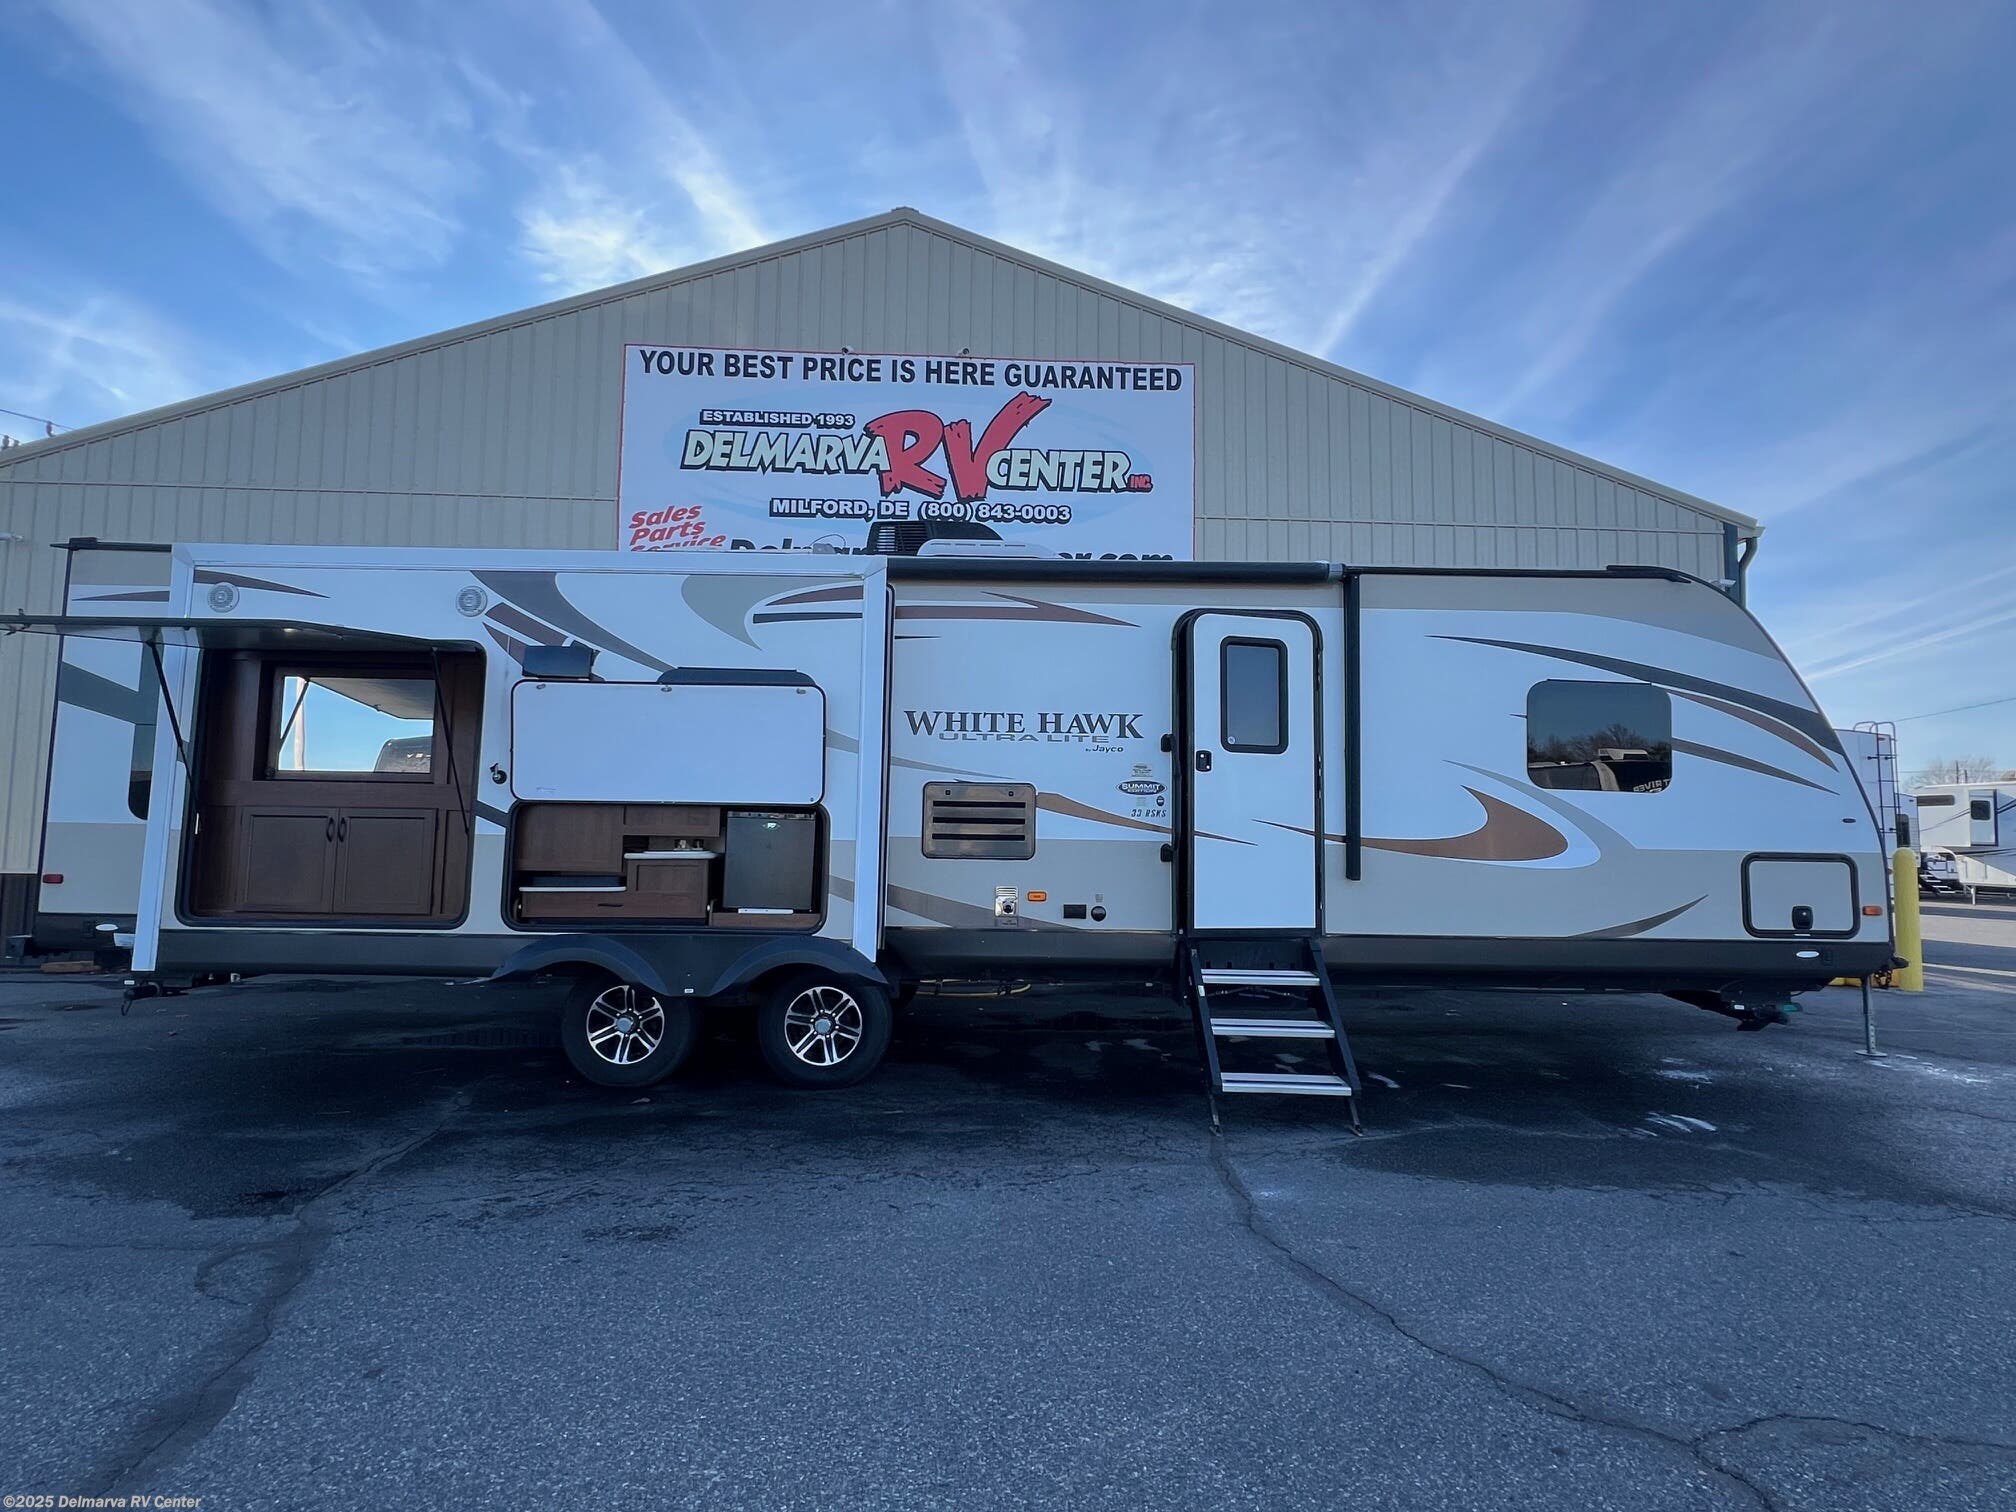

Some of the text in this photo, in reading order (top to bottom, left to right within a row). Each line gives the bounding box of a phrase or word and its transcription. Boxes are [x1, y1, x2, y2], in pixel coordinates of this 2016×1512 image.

[640, 349, 1182, 391] YOUR BEST PRICE IS HERE GUARANTEED
[701, 410, 855, 428] ESTABLISHED 1993
[680, 429, 892, 474] DELMARVA
[864, 391, 1052, 503] RV
[985, 448, 1131, 492] CENTER
[629, 505, 702, 529] Sales
[770, 499, 1071, 524] MILFORD, DE (800) 843-0003
[630, 521, 706, 546] Parts
[904, 711, 1144, 739] WHITE HAWK
[939, 733, 1109, 743] ULTRA LITE
[1092, 745, 1124, 753] Jayco
[1121, 783, 1160, 791] SUMMIT
[1131, 809, 1142, 817] 33
